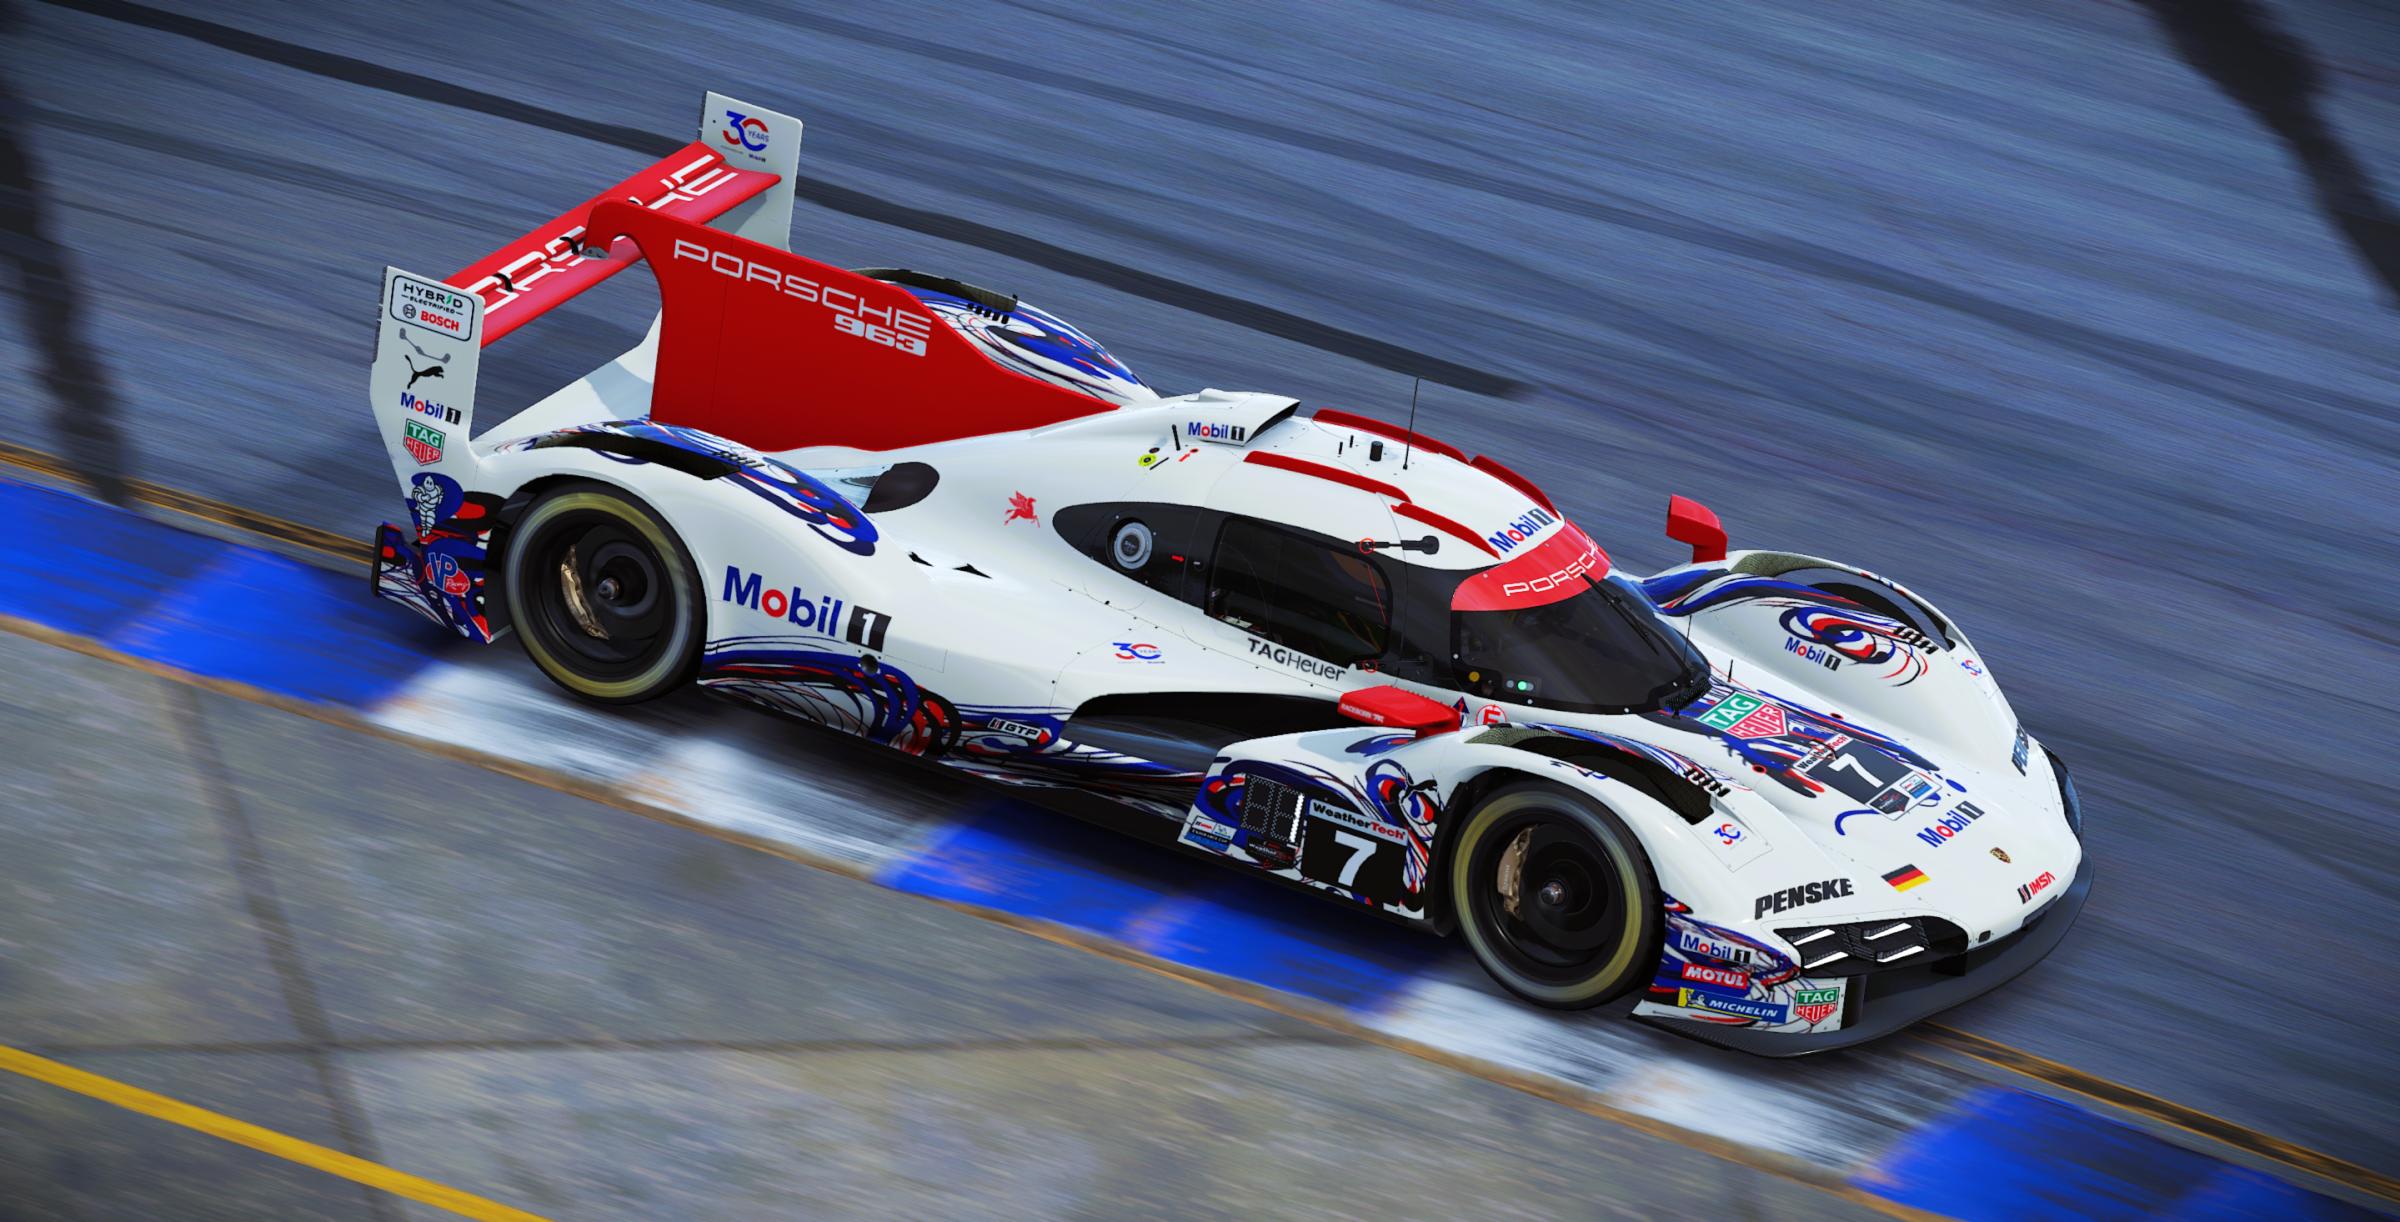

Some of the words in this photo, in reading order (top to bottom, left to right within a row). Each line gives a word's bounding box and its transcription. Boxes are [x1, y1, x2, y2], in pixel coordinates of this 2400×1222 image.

[748, 130, 769, 143] YEARS
[674, 239, 932, 339] PORSCHE
[420, 310, 460, 332] BOSCH
[834, 313, 928, 357] 963
[401, 391, 444, 419] Mobil
[409, 424, 440, 447] TAG
[1188, 422, 1228, 439] Mobil
[406, 439, 440, 462] HEUER
[1488, 514, 1541, 552] Mobil
[428, 552, 458, 591] VP
[722, 565, 843, 637] Mobil
[1783, 636, 1825, 664] Mobil
[1703, 697, 1756, 726] TAG
[1728, 706, 1781, 736] HEUER
[1005, 722, 1039, 736] GTP
[1828, 752, 1885, 788] 7
[1313, 802, 1405, 840] WeatherTech
[1916, 809, 1972, 848] Mobil
[1334, 830, 1378, 887] 7
[2028, 871, 2056, 896] IMSA
[1754, 878, 1855, 920] PENSKE
[1684, 934, 1731, 960] Mobil
[1685, 965, 1745, 987] MOTUL
[1708, 999, 1778, 1018] MICHELIN
[1800, 991, 1835, 1003] TAG
[1796, 1004, 1837, 1022] HEUER
